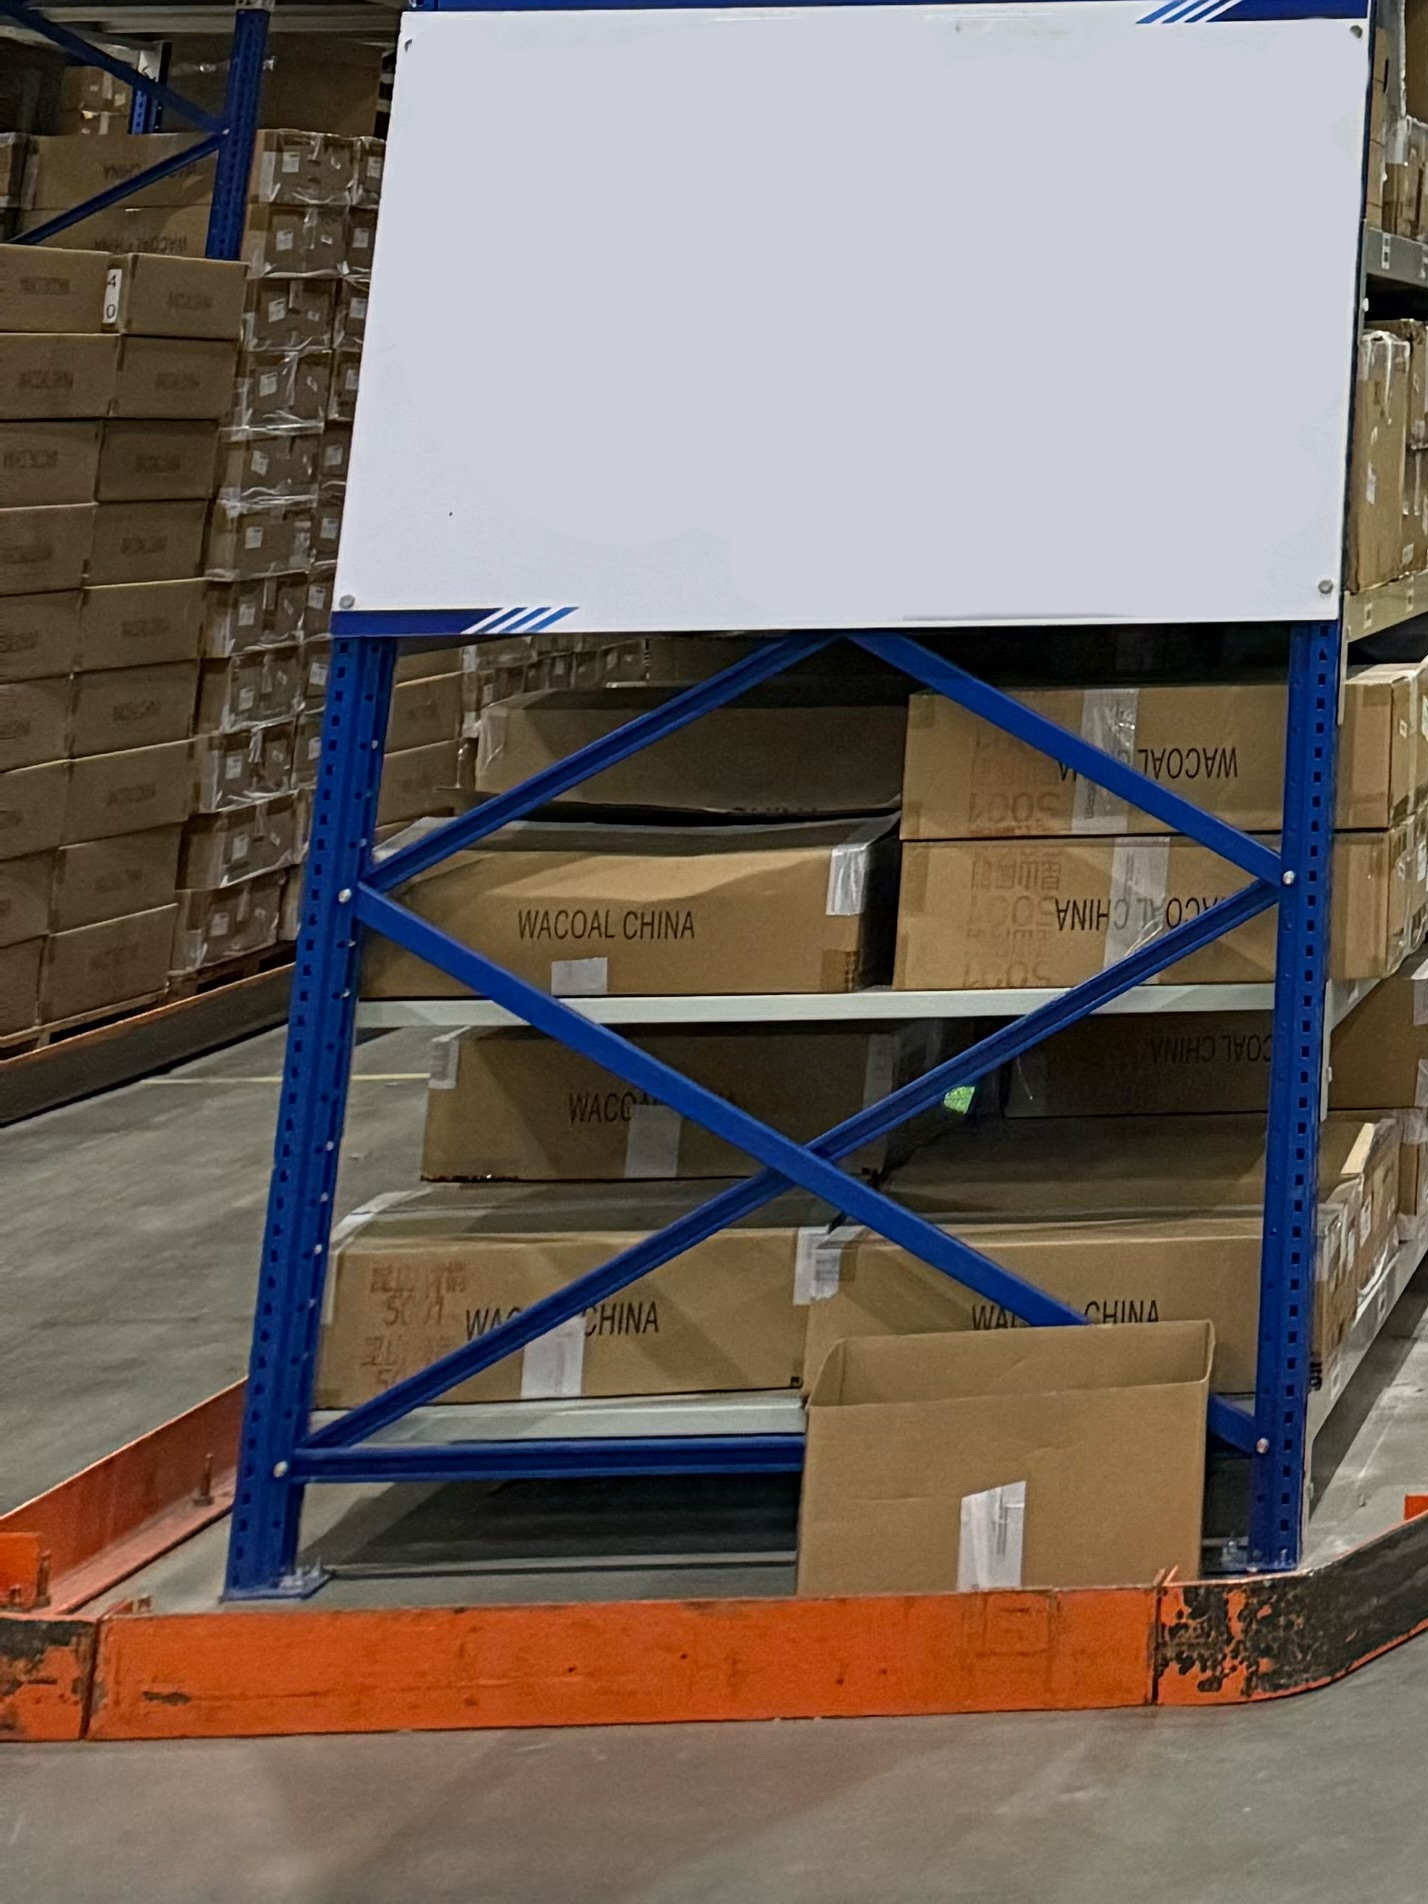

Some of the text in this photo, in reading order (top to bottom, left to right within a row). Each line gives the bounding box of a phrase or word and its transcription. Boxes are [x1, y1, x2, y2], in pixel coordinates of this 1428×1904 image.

[1138, 748, 1238, 779] WACOAL
[518, 909, 695, 941] WACOAL CHINA
